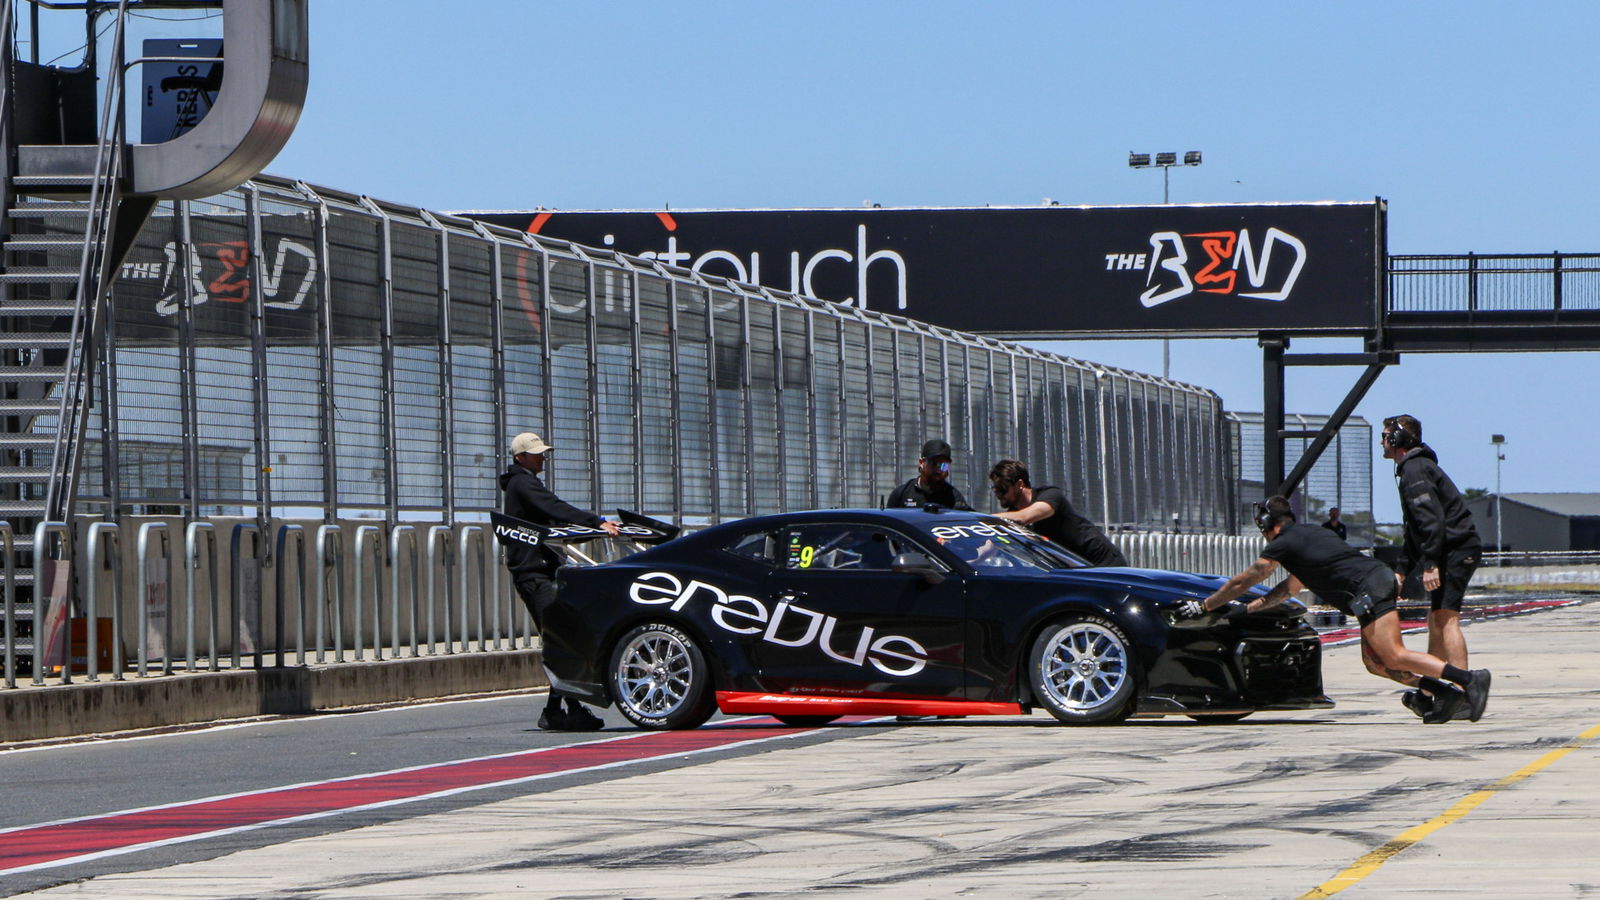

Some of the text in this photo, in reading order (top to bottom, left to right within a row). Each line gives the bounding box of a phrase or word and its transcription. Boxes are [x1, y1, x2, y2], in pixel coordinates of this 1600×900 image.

[121, 262, 162, 279] THE
[1105, 227, 1307, 308] THE BEND
[799, 545, 814, 568] 9
[629, 572, 928, 676] erebus
[649, 623, 692, 648] DUNLOP
